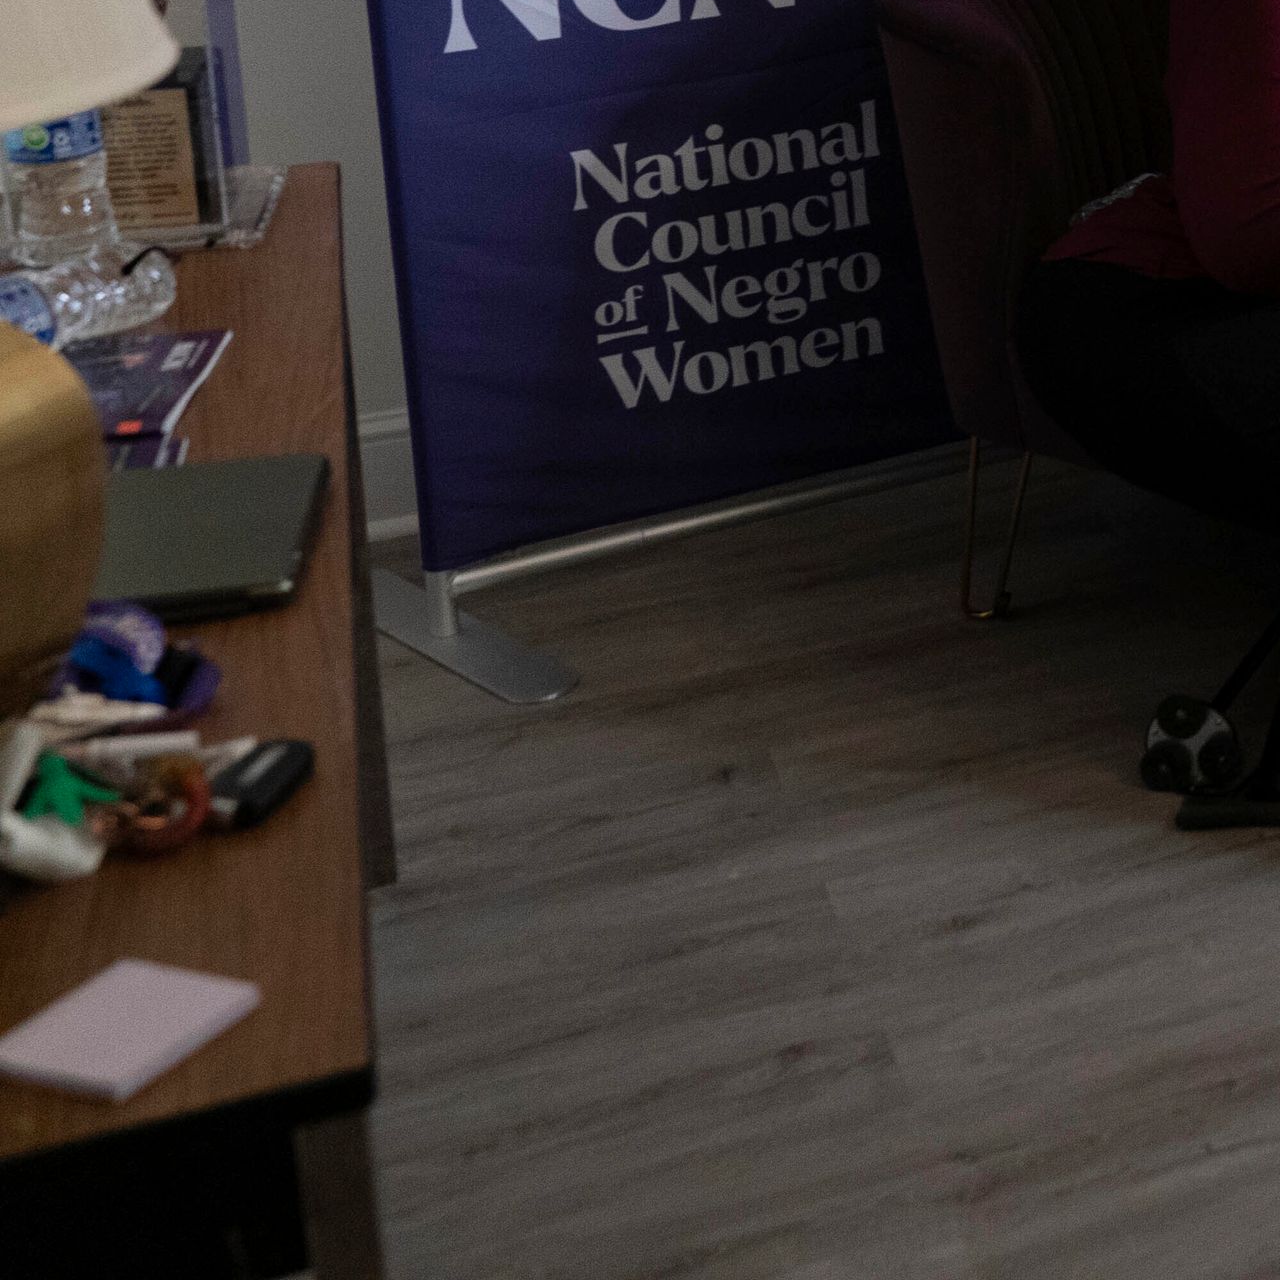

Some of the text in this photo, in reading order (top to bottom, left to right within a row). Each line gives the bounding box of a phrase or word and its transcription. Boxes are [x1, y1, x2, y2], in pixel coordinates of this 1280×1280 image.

[569, 98, 881, 212] National
[594, 167, 871, 273] Council
[594, 251, 882, 332] of Negro
[598, 316, 885, 409] Women
